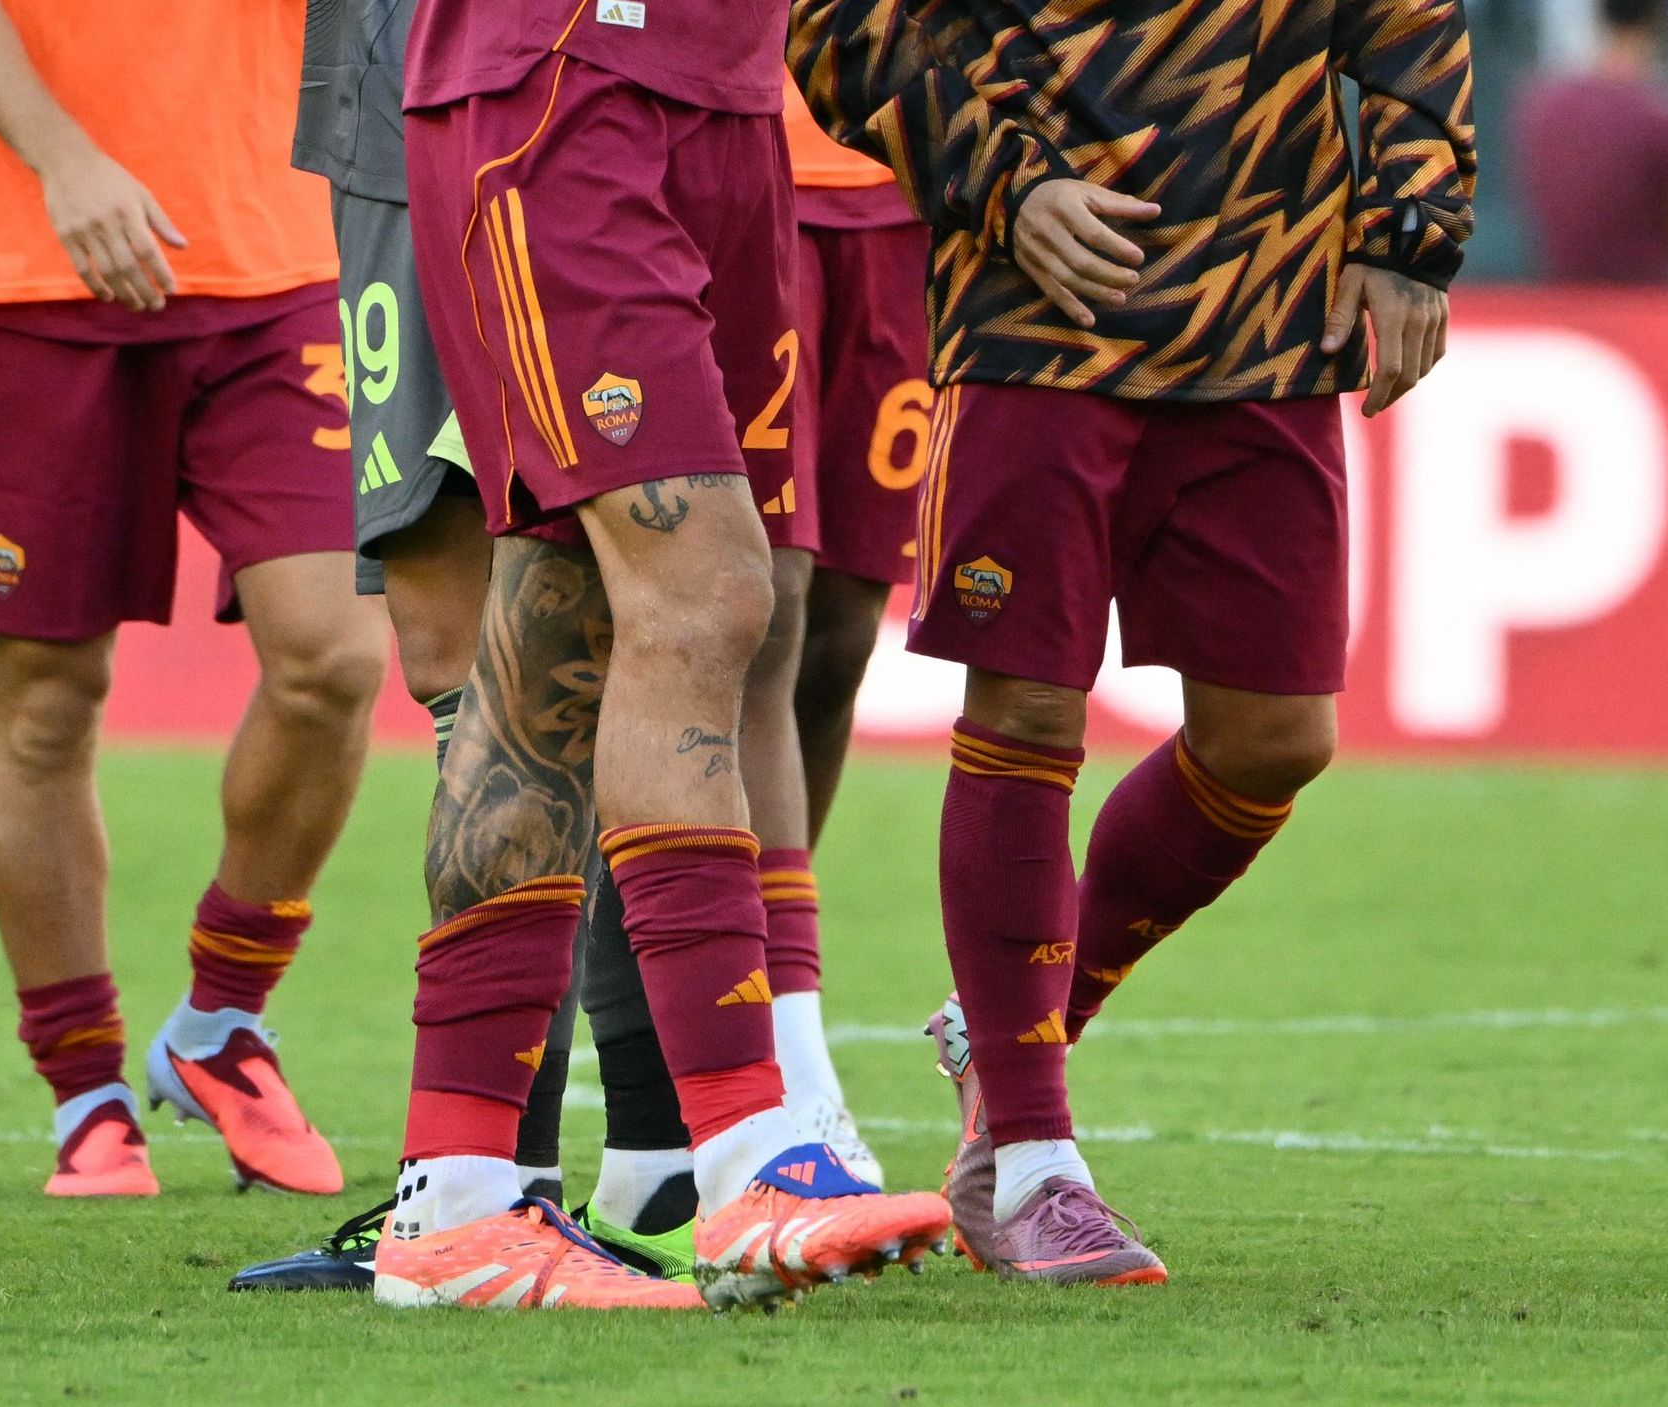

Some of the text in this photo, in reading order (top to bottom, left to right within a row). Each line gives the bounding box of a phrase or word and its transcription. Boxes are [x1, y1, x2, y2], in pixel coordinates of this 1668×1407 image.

[741, 328, 799, 449] 2
[596, 411, 638, 431] ROMA
[868, 378, 934, 491] 6
[959, 593, 1003, 610] ROMA
[1028, 941, 1077, 965] ASR
